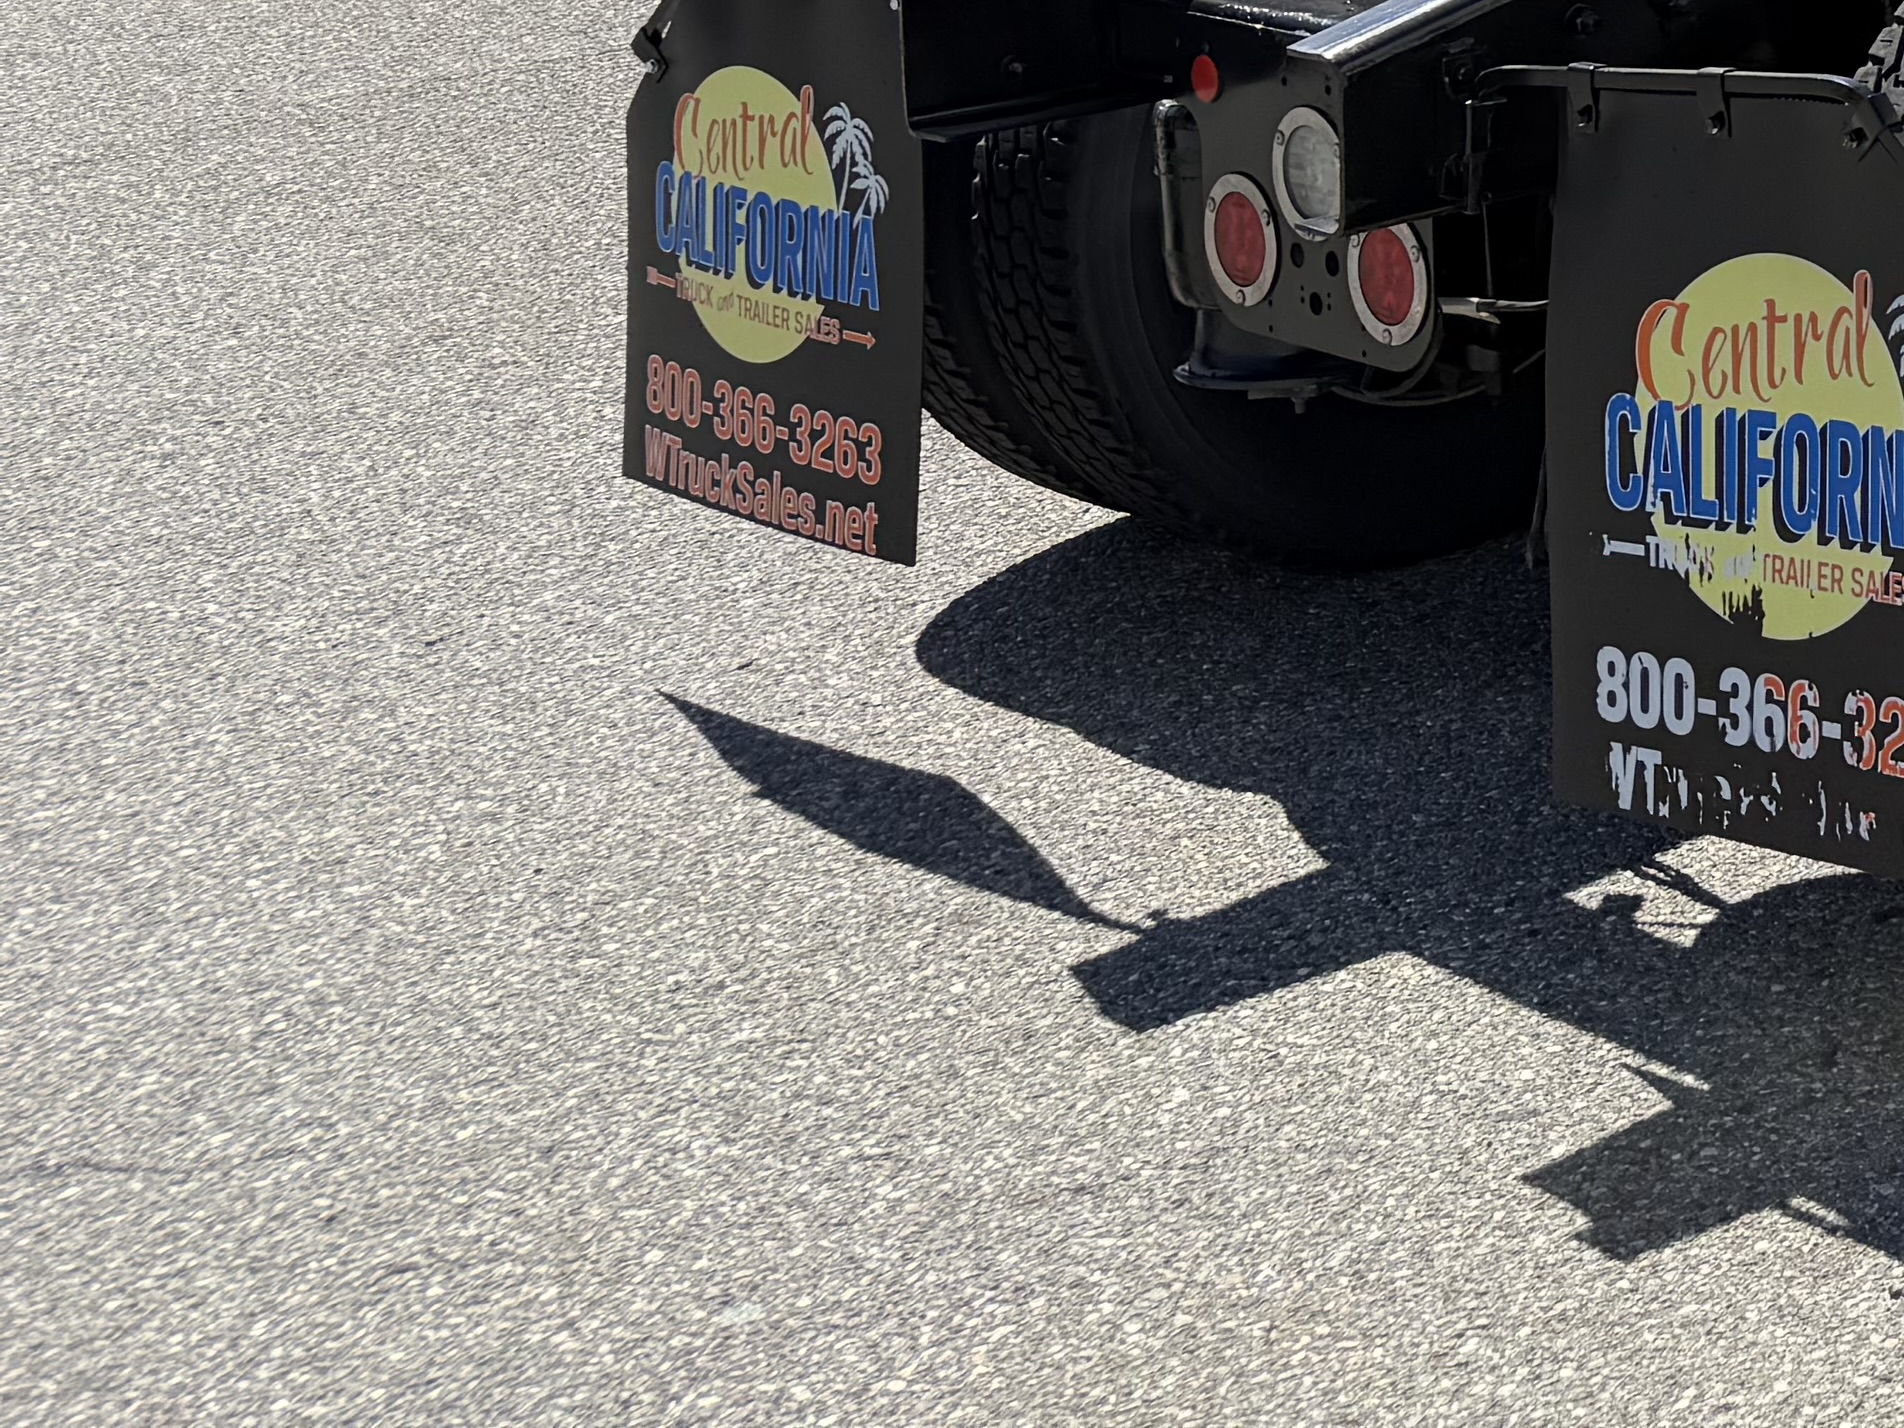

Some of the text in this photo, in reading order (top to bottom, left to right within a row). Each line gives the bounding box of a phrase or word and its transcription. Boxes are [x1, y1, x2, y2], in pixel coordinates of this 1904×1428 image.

[674, 84, 814, 181] Central
[655, 160, 880, 311] CALIFORNIA
[675, 272, 714, 309] TRUCK
[736, 294, 790, 332] TRAILER
[795, 311, 841, 345] SALES
[1635, 269, 1874, 411] Central
[646, 354, 882, 486] 800-366-3263
[1762, 554, 1844, 596] TRAILER
